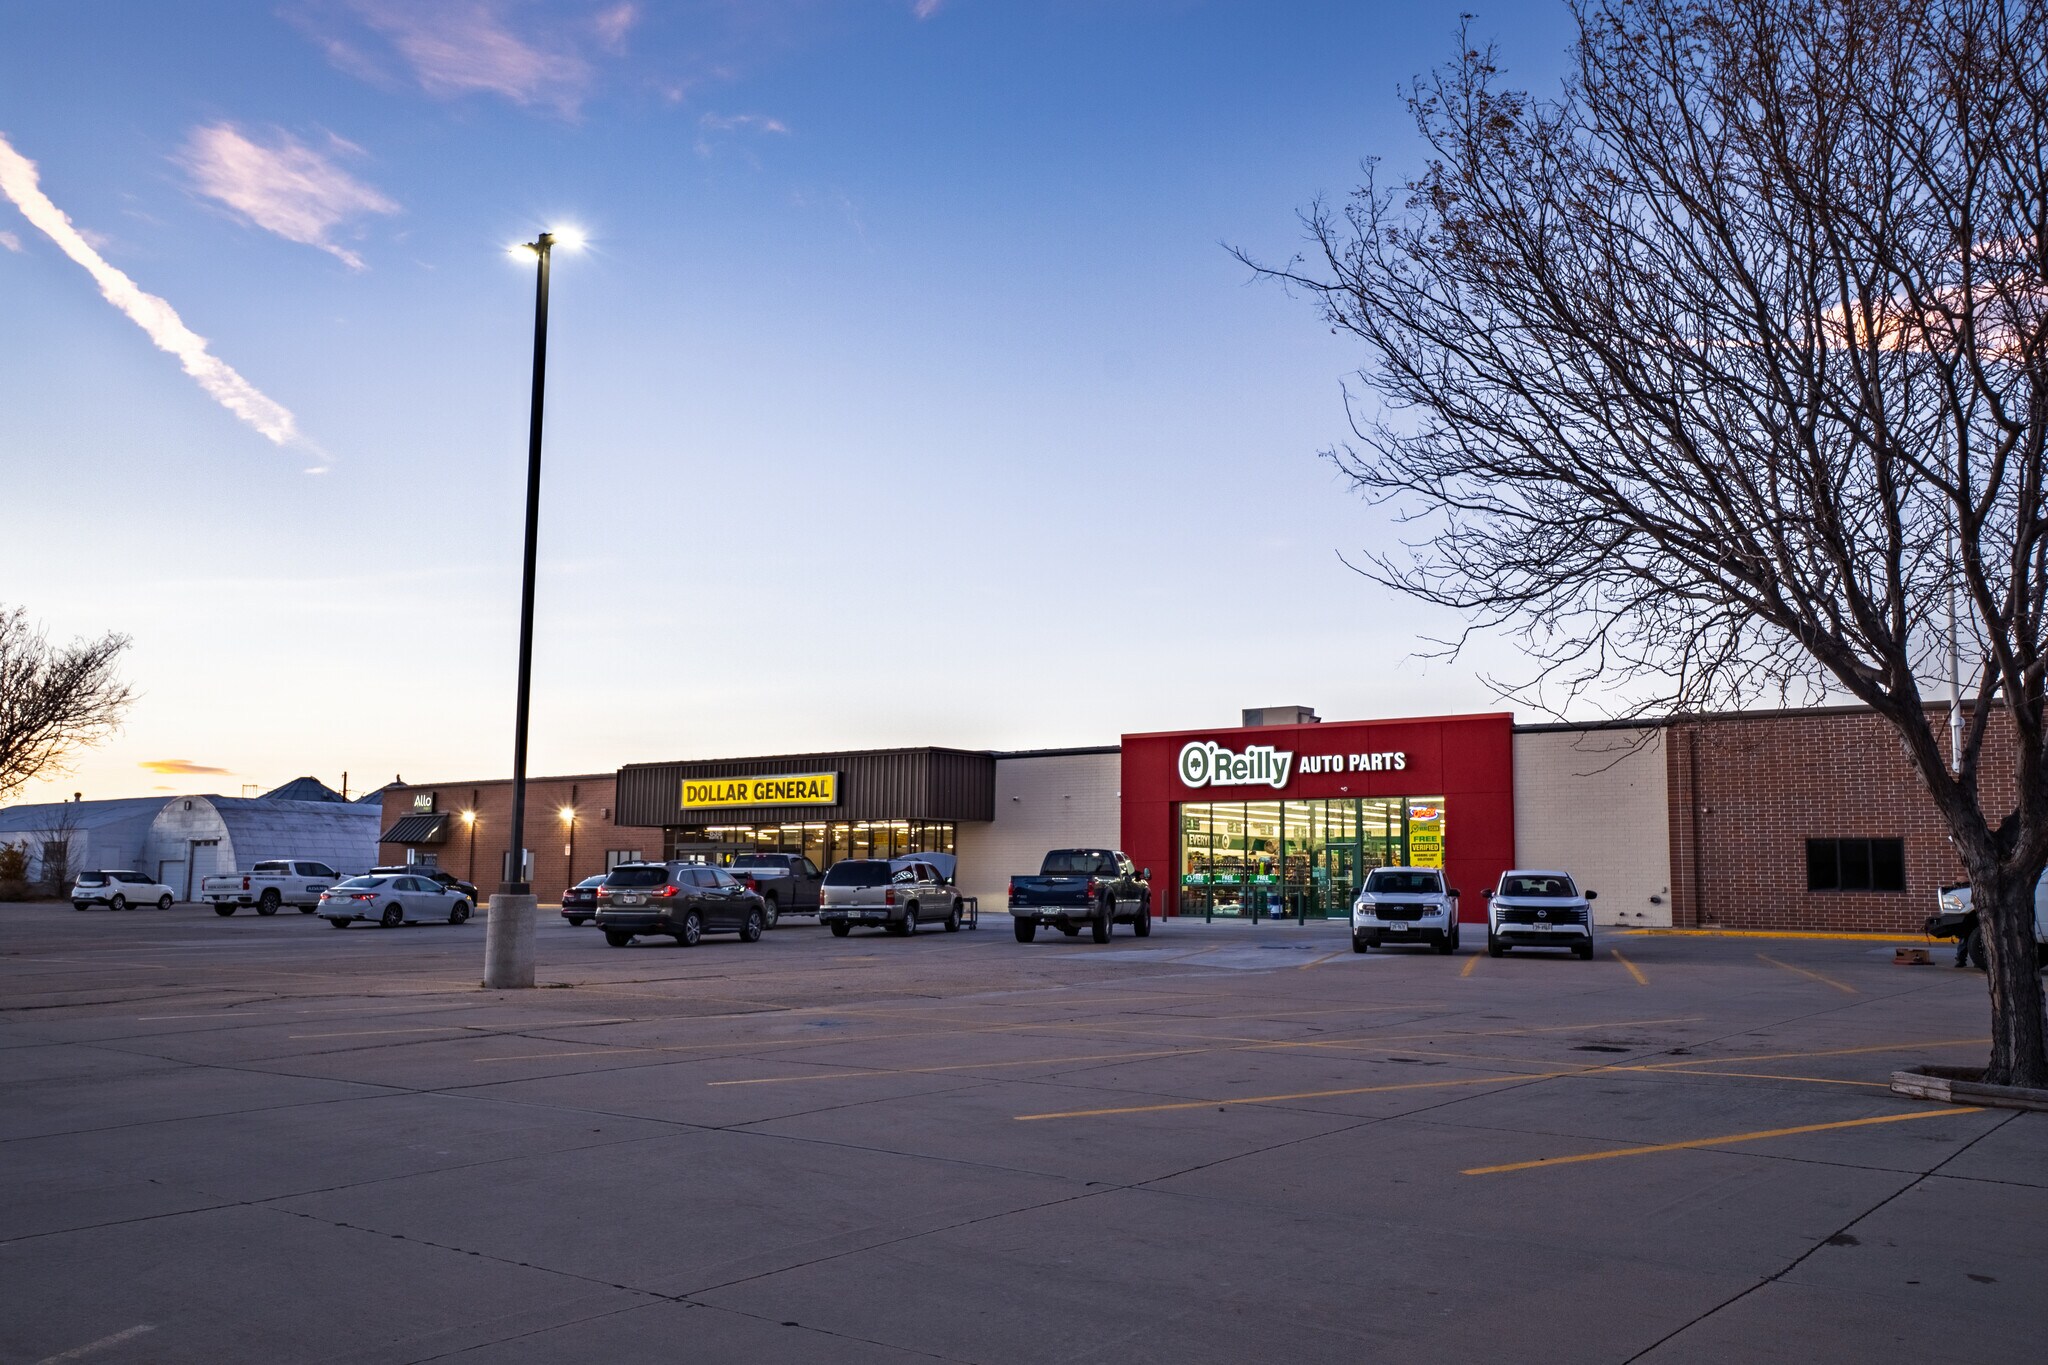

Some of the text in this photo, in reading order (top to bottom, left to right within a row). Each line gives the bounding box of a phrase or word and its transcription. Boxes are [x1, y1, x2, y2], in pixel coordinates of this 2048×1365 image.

[1181, 745, 1406, 785] O'Reilly AUTO PARTS
[686, 779, 830, 803] DOLLAR GENERAL
[414, 794, 432, 807] Allo
[1413, 807, 1437, 818] OPEN
